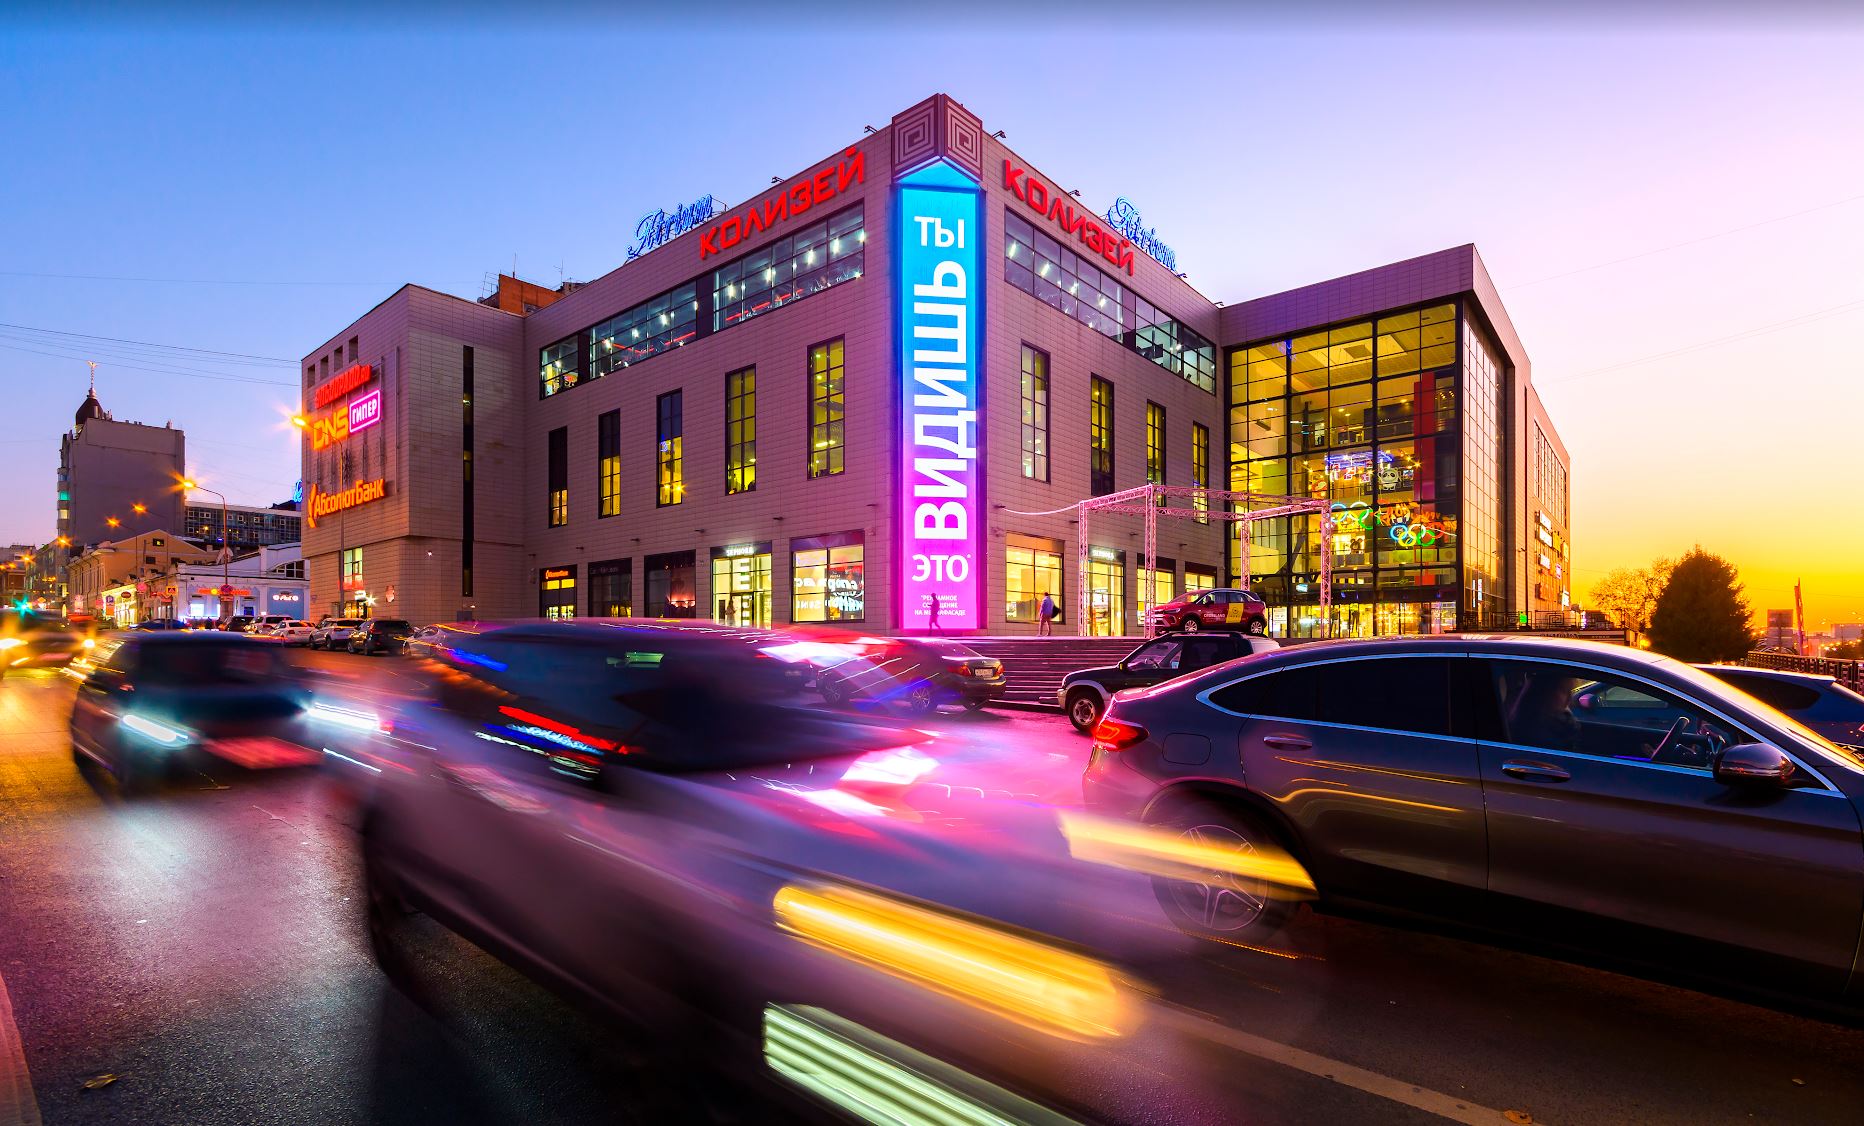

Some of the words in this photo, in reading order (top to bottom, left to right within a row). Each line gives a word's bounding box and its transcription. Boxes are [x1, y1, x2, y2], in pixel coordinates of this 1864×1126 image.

[700, 146, 864, 260] КОЛИЗЕЙ
[914, 215, 966, 249] ТЫ
[1003, 159, 1134, 276] КОЛИЗЕЙ
[313, 406, 348, 450] DNS
[352, 398, 377, 425] ГИПЕР
[914, 260, 976, 540] ВИДИШЬ
